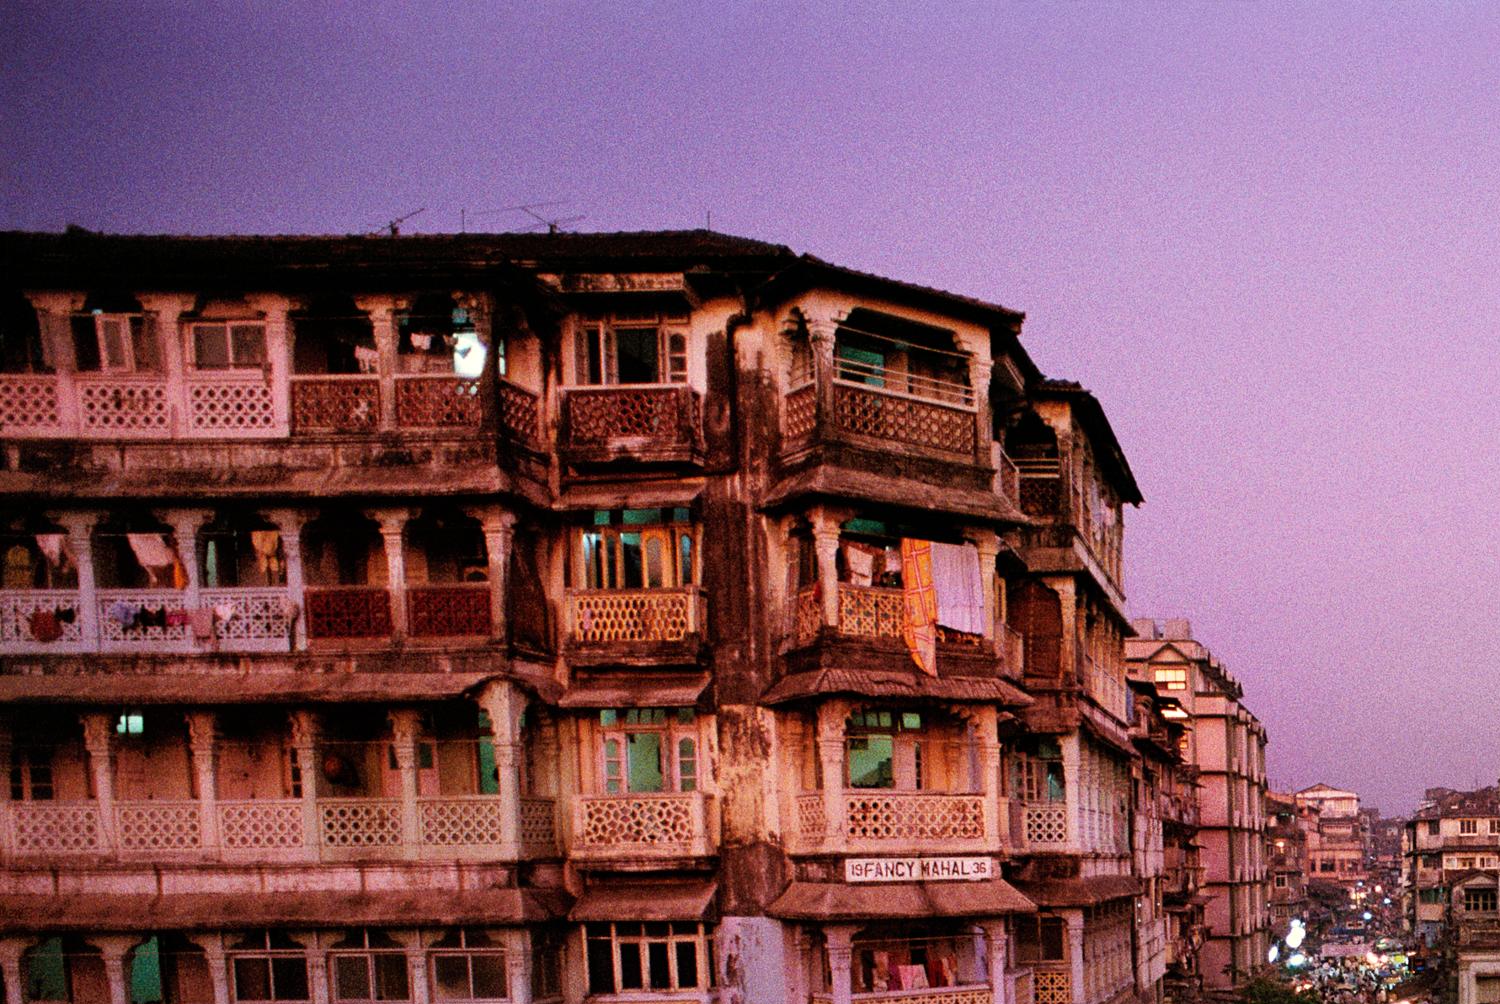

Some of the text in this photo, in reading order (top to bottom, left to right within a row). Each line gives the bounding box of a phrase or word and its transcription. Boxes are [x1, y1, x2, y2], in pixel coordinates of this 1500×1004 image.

[851, 860, 987, 878] 19 FANCY MAHAL 36
